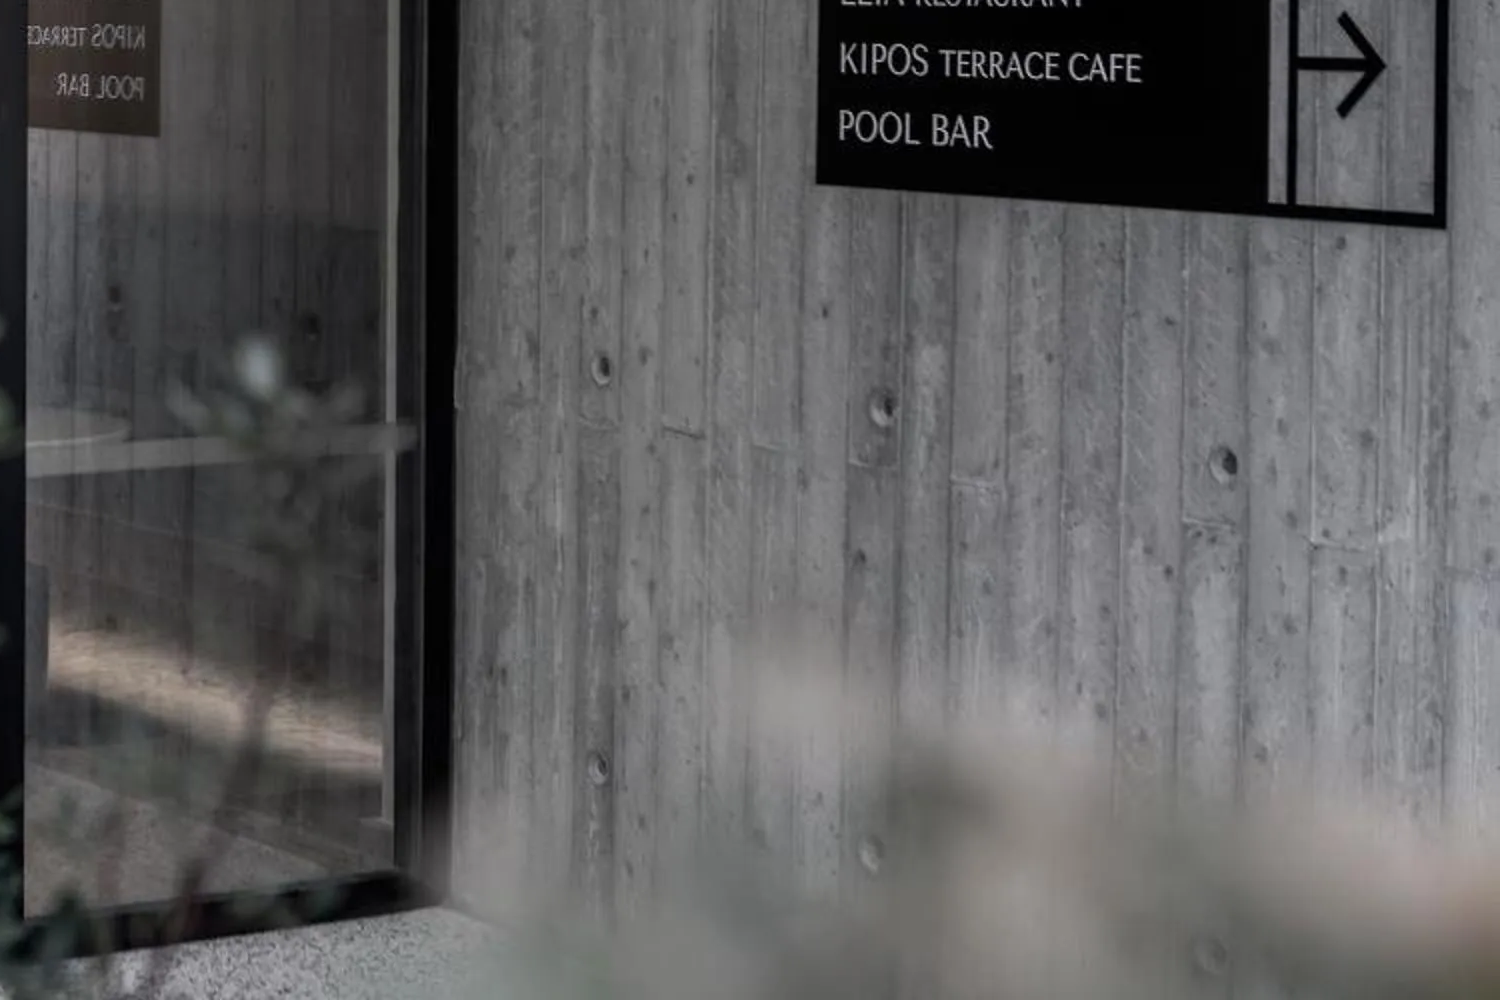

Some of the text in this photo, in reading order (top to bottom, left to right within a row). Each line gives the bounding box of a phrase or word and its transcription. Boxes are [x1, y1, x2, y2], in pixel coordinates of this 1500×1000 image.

[840, 42, 1143, 83] KIPOS TERRACE CAFE
[839, 109, 994, 150] POOL BAR
